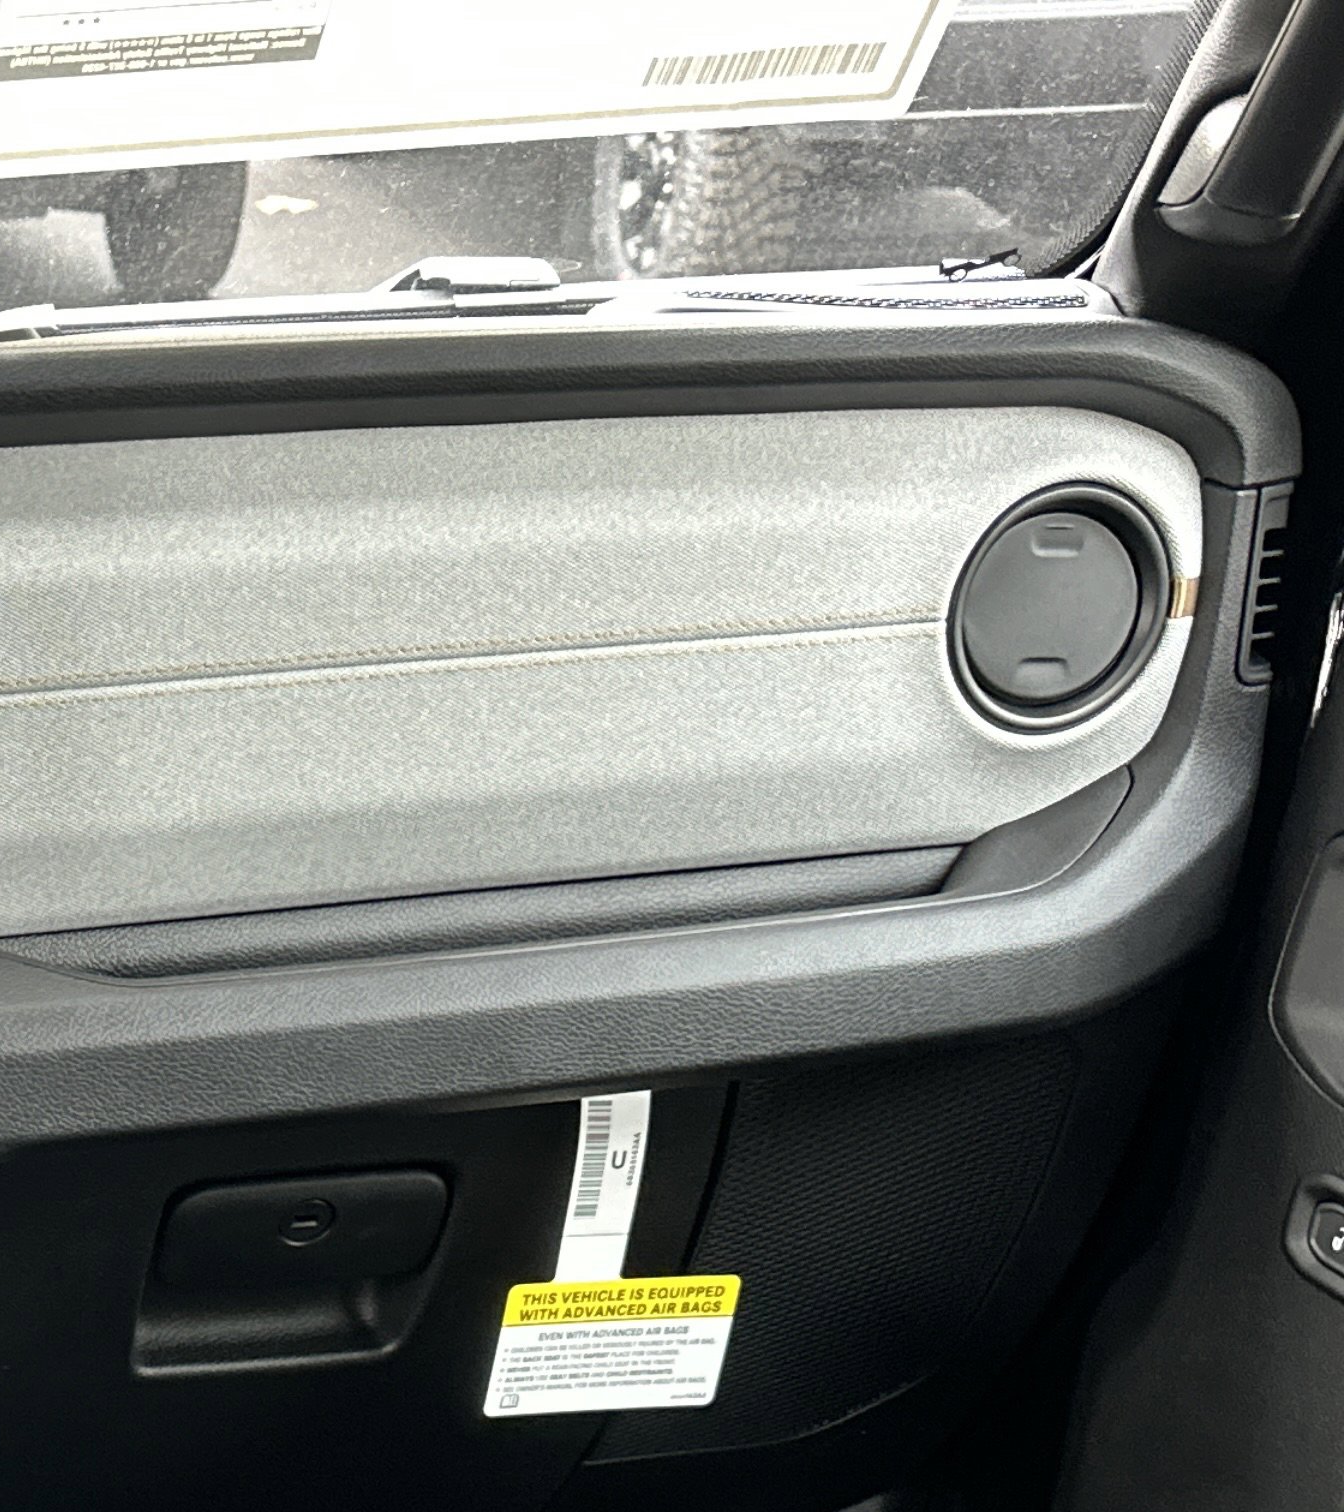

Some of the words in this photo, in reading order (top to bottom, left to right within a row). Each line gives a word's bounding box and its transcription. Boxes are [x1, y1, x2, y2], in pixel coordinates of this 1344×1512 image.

[612, 1150, 627, 1169] U
[523, 1293, 557, 1306] THIS
[562, 1288, 626, 1304] VEHICLE
[630, 1288, 644, 1300] IS
[648, 1286, 726, 1299] EQUIPPED
[520, 1308, 560, 1322] WITH
[562, 1304, 647, 1319] ADVANCED
[650, 1303, 676, 1315] AIR
[680, 1301, 722, 1313] BAGS
[538, 1331, 564, 1342] EVEN
[566, 1330, 590, 1339] WITH
[592, 1328, 643, 1339] ADVANCED
[646, 1327, 661, 1335] AIR
[664, 1326, 689, 1335] BAGS
